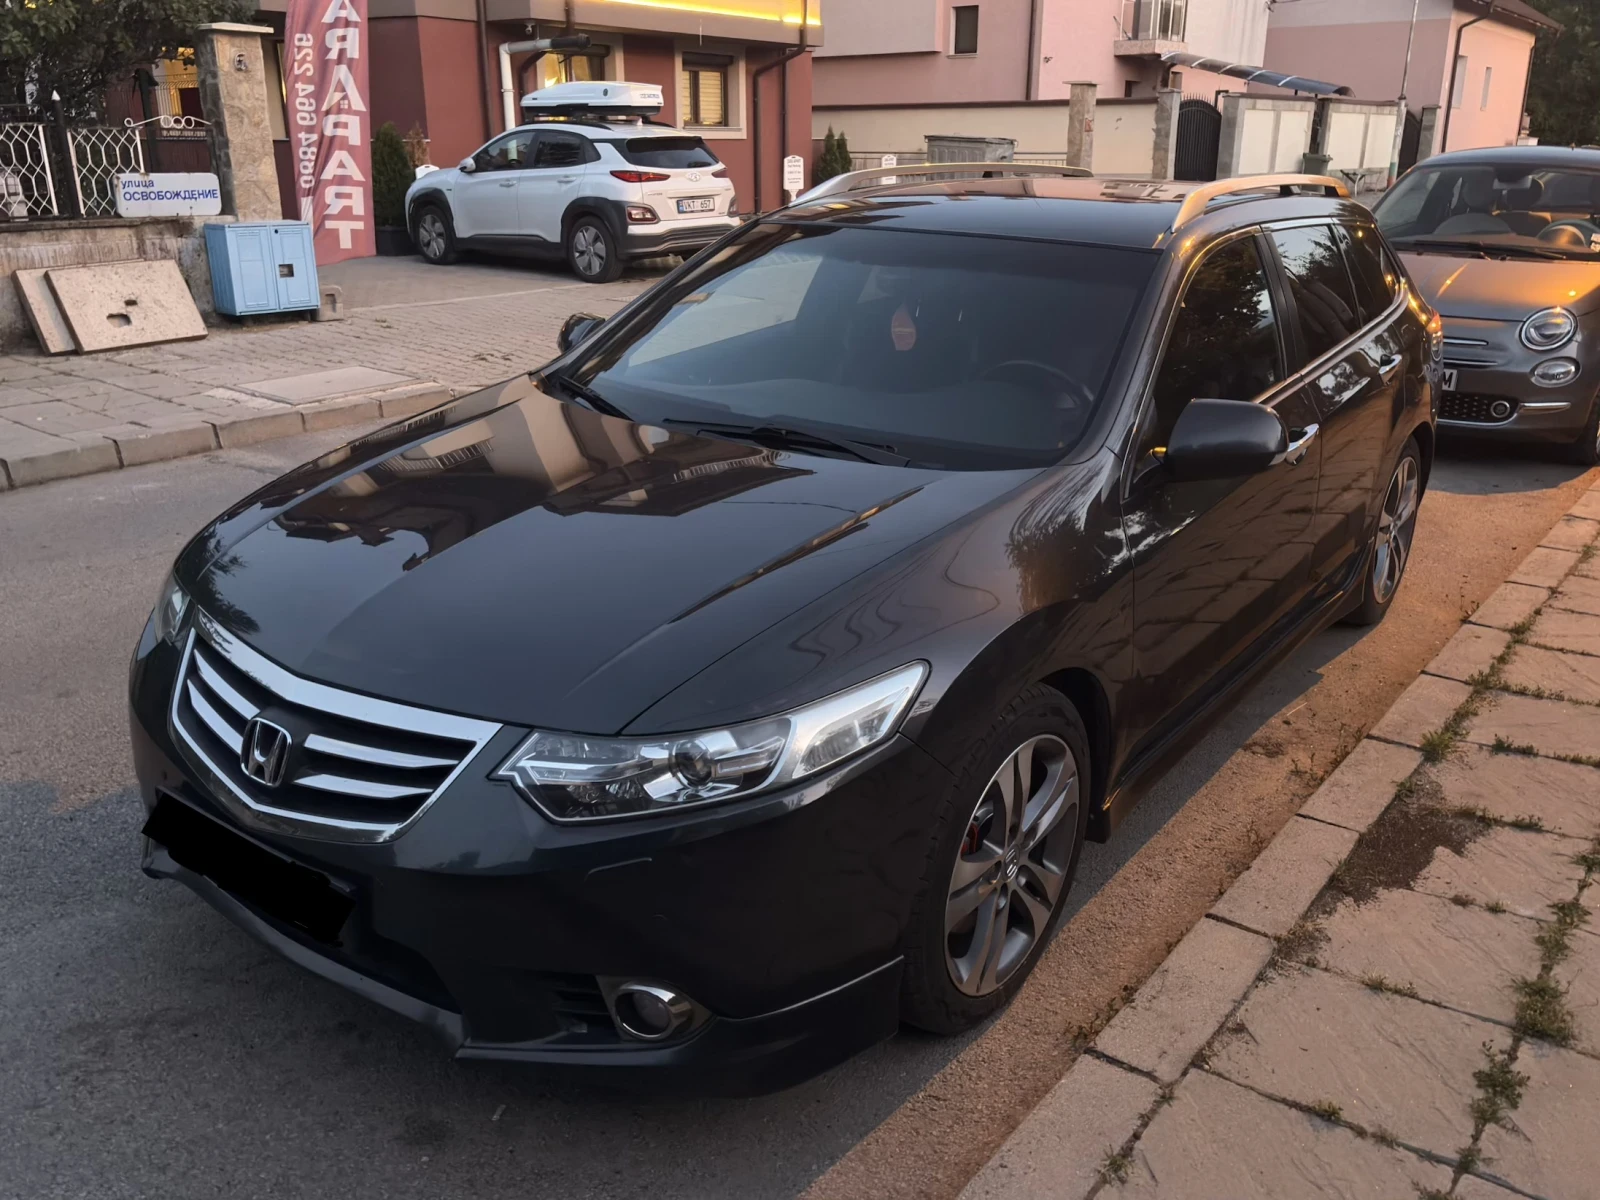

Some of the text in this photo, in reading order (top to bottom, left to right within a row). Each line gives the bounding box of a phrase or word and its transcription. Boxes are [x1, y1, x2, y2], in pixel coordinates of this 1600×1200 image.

[121, 180, 155, 189] улица
[123, 189, 219, 201] ОСВОБОЖДЕНИЕ
[701, 199, 711, 209] 657
